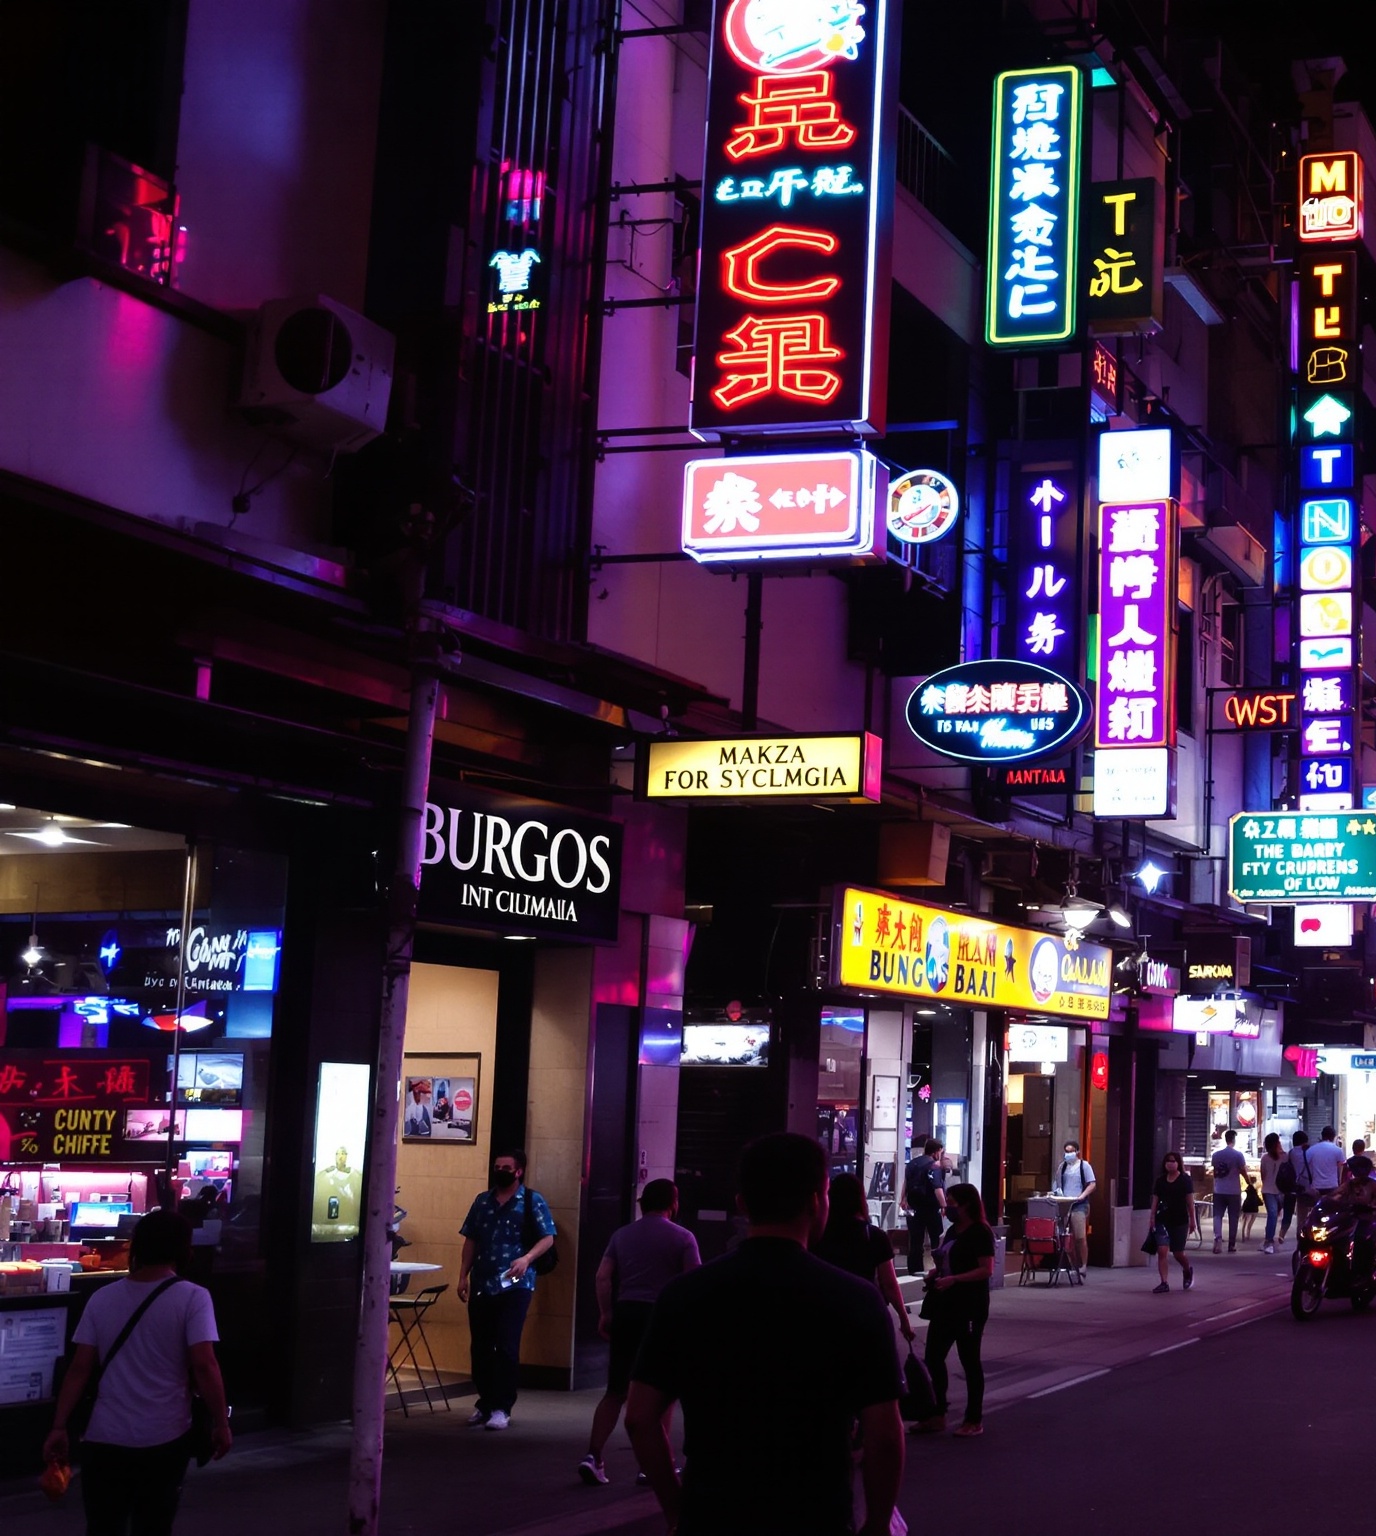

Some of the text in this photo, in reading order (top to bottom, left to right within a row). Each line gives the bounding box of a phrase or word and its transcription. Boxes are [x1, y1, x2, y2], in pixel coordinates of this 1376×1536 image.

[718, 745, 806, 766] MAKZA
[664, 767, 847, 789] FOR SYCLMGIA
[421, 801, 611, 894] BURGOS
[1254, 844, 1284, 859] THE
[461, 884, 493, 909] INT
[869, 950, 924, 988] BUNG
[54, 1109, 117, 1131] CUNTY
[53, 1134, 111, 1155] CHIFFE
